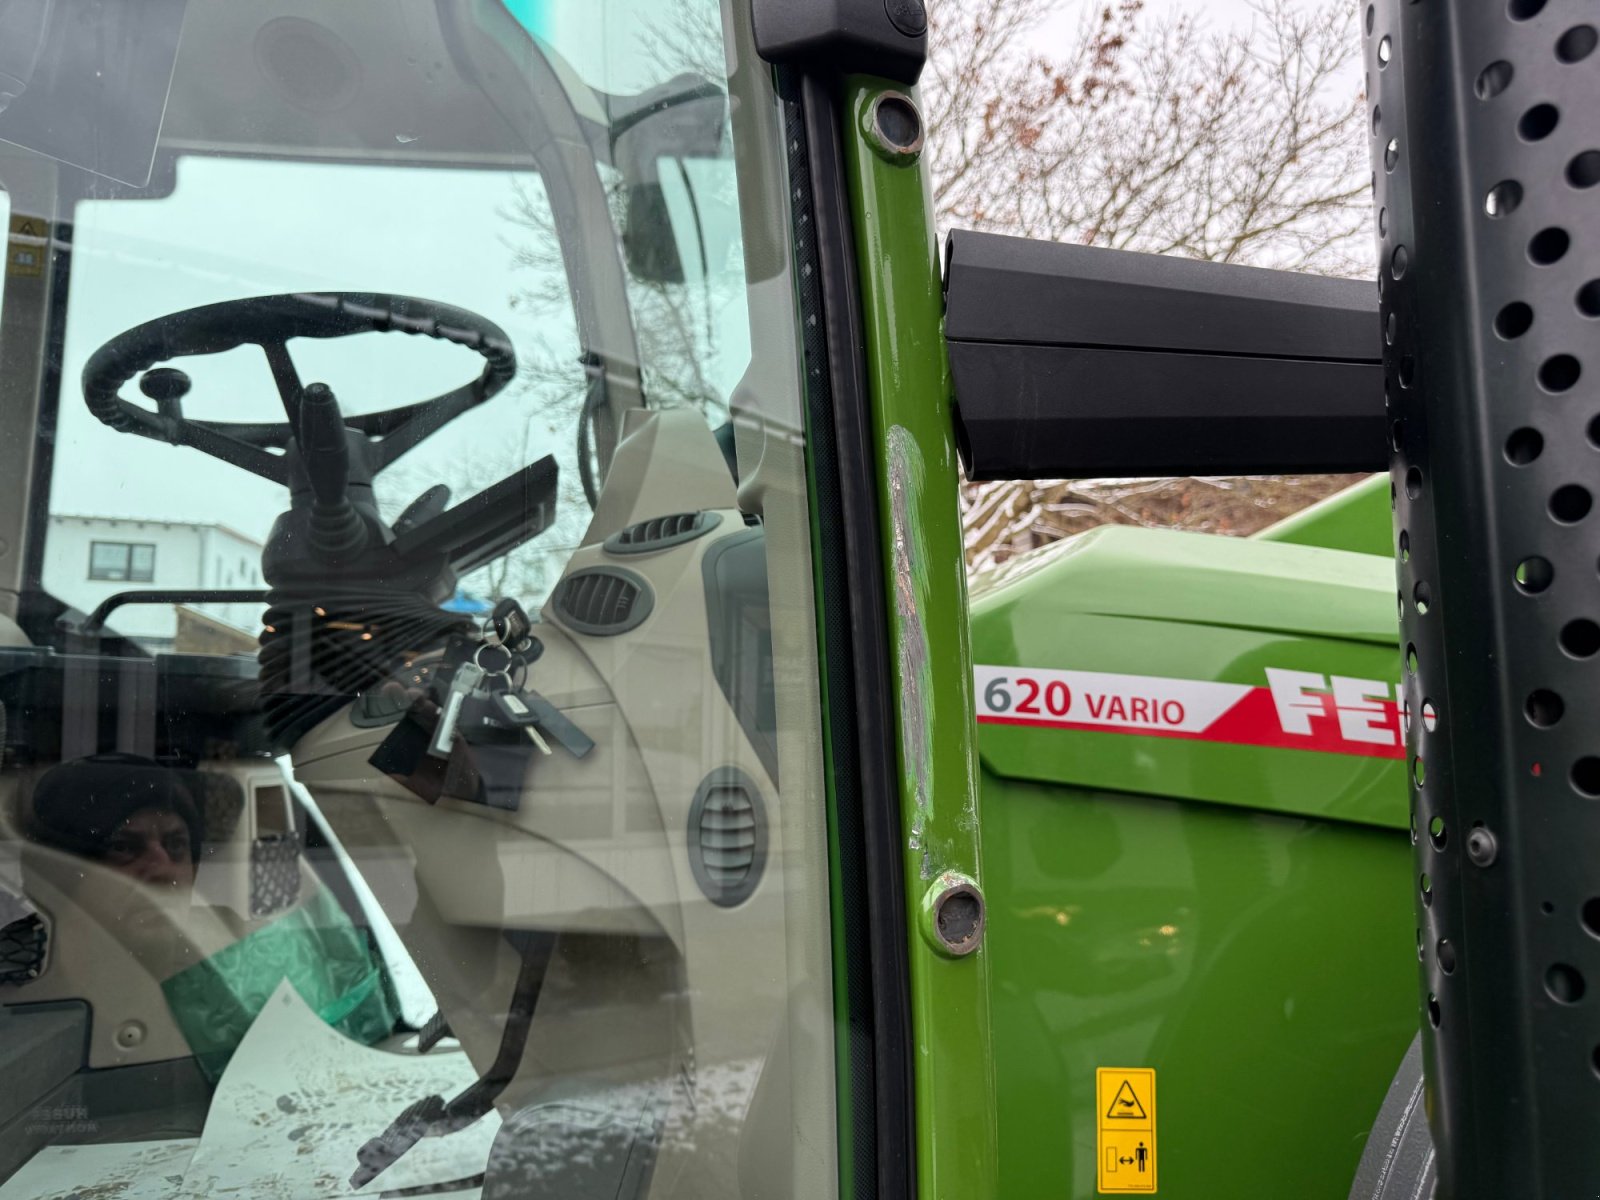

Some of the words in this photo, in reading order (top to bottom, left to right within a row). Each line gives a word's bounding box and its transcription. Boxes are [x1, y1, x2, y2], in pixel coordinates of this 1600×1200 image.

[984, 677, 1072, 717] 620
[1084, 692, 1186, 726] VARIO
[1264, 666, 1407, 748] FE
